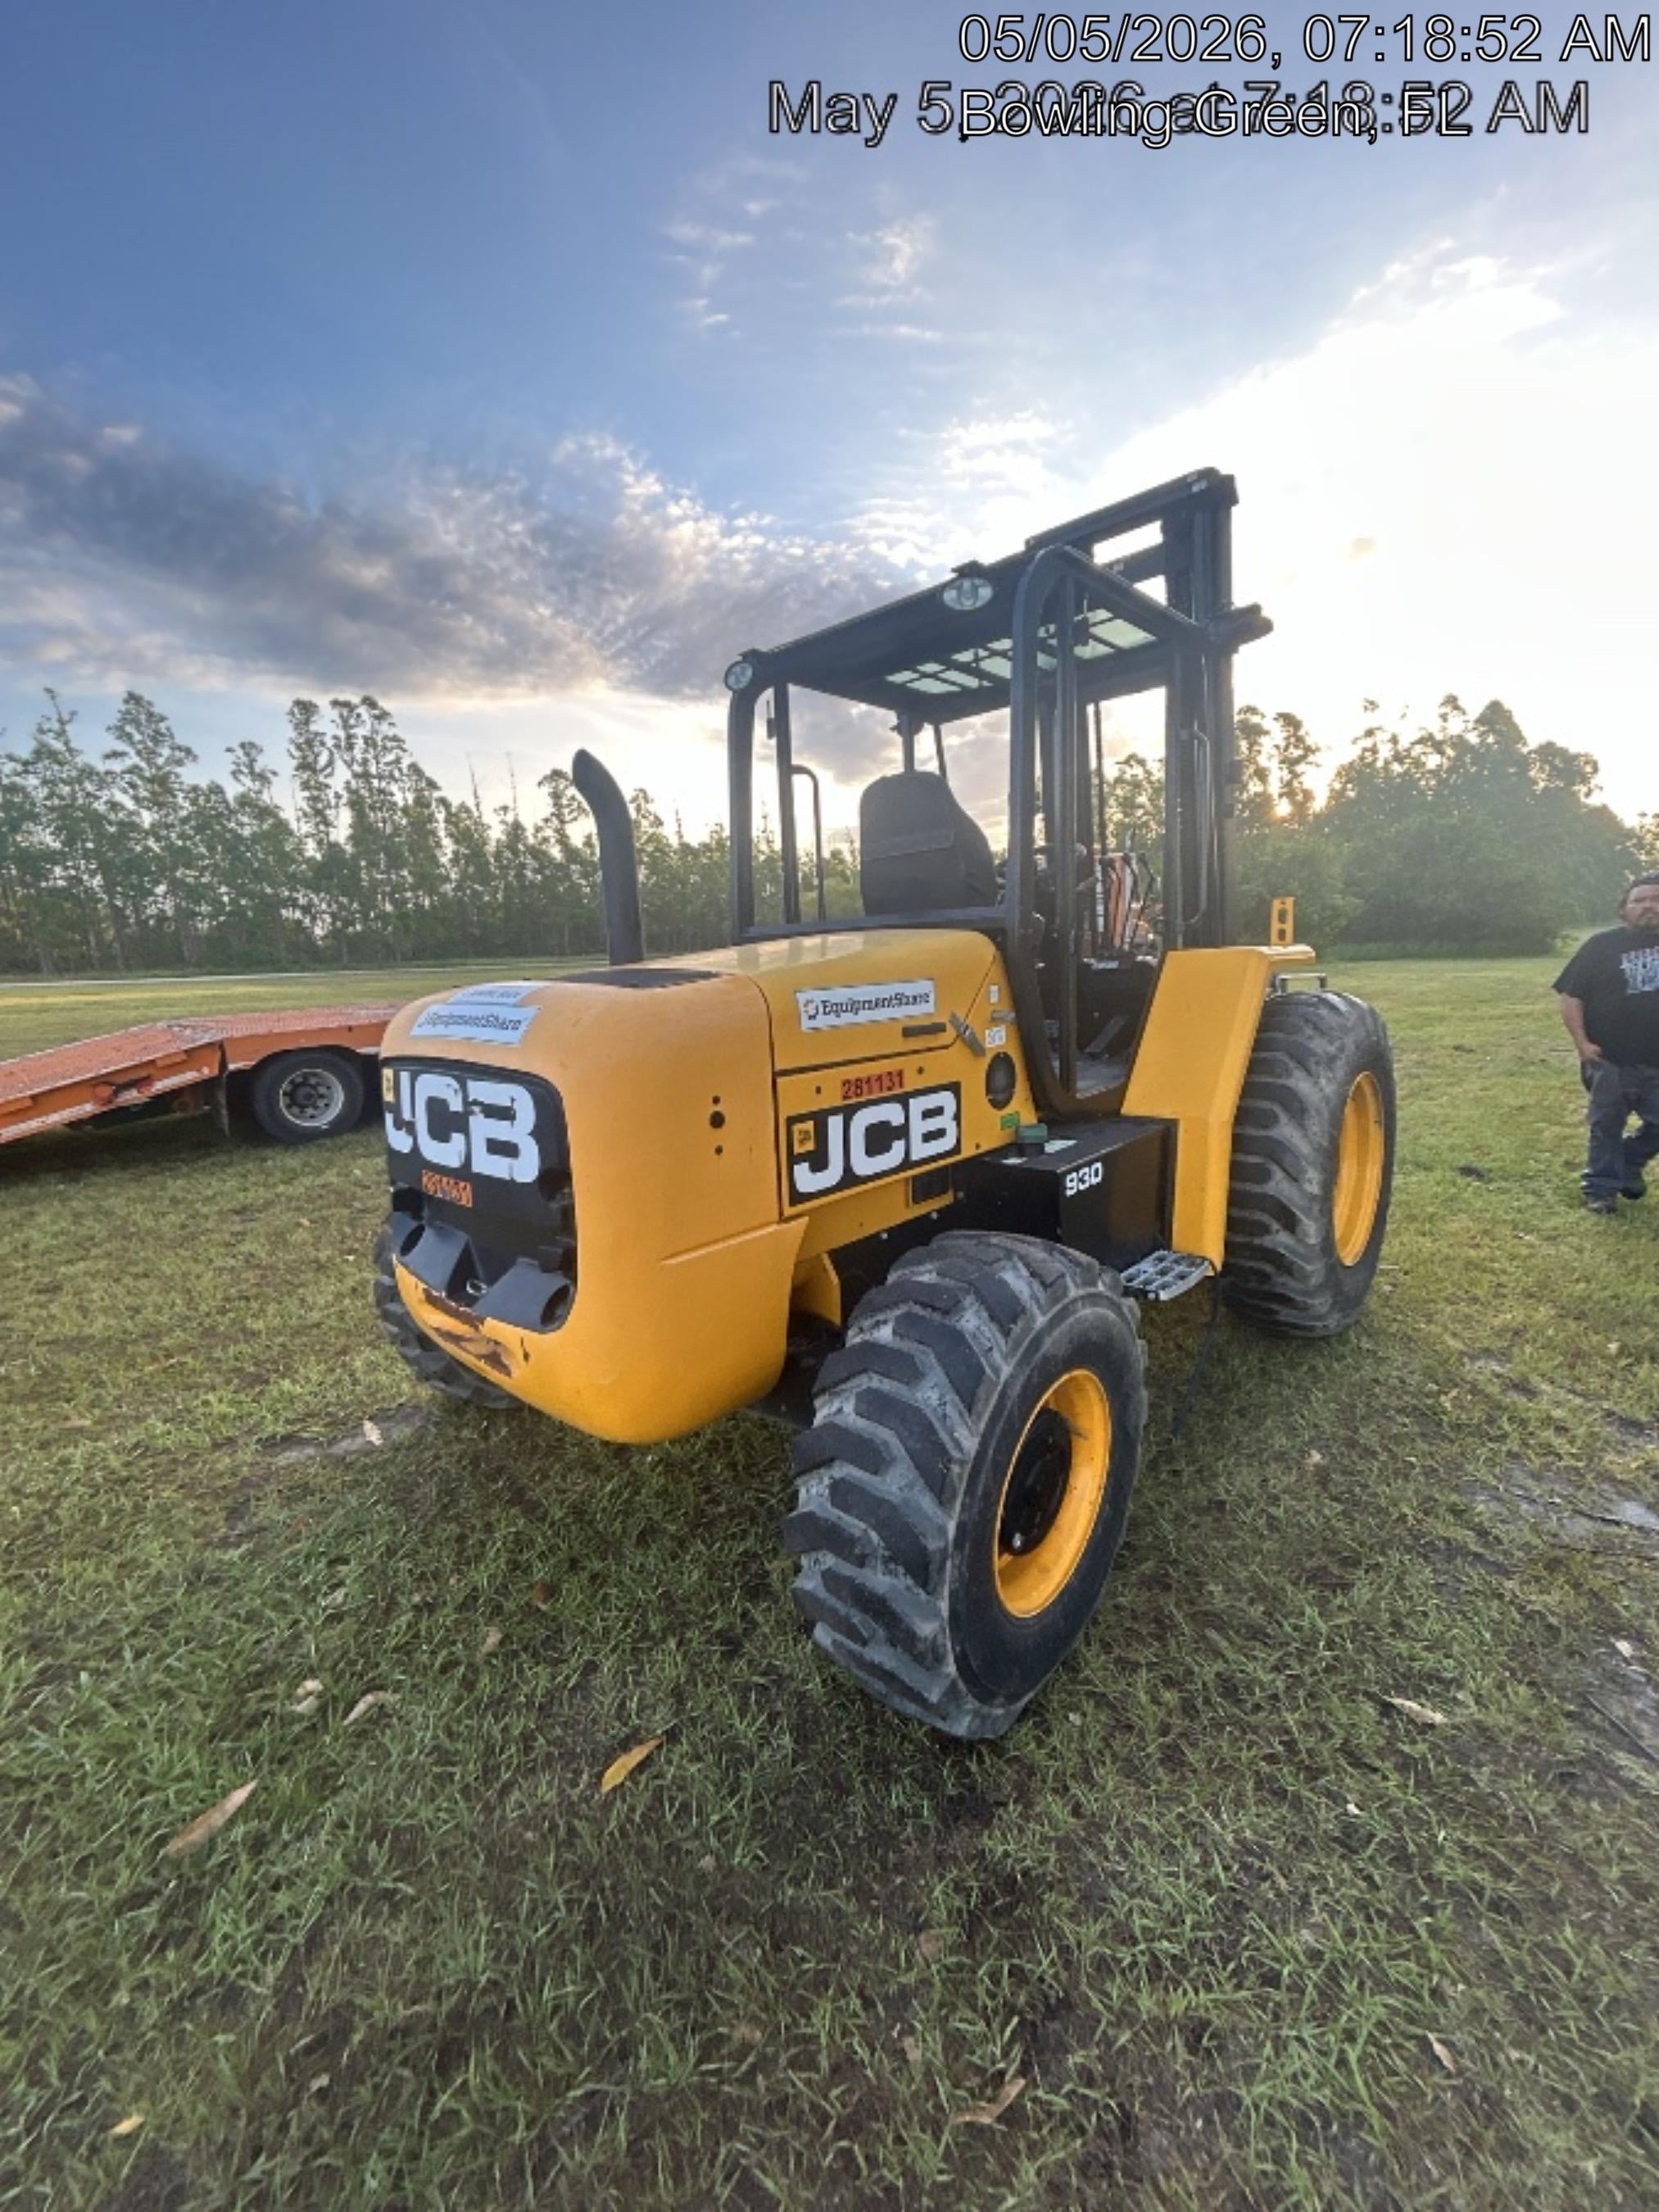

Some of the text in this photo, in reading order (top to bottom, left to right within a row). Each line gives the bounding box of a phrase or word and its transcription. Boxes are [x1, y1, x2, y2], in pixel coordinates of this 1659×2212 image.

[820, 990, 931, 1018] EquipmentShare
[841, 1068, 904, 1101] 281131
[384, 1071, 542, 1183] JCB
[792, 1090, 959, 1194] JCB
[1065, 1162, 1103, 1197] 930
